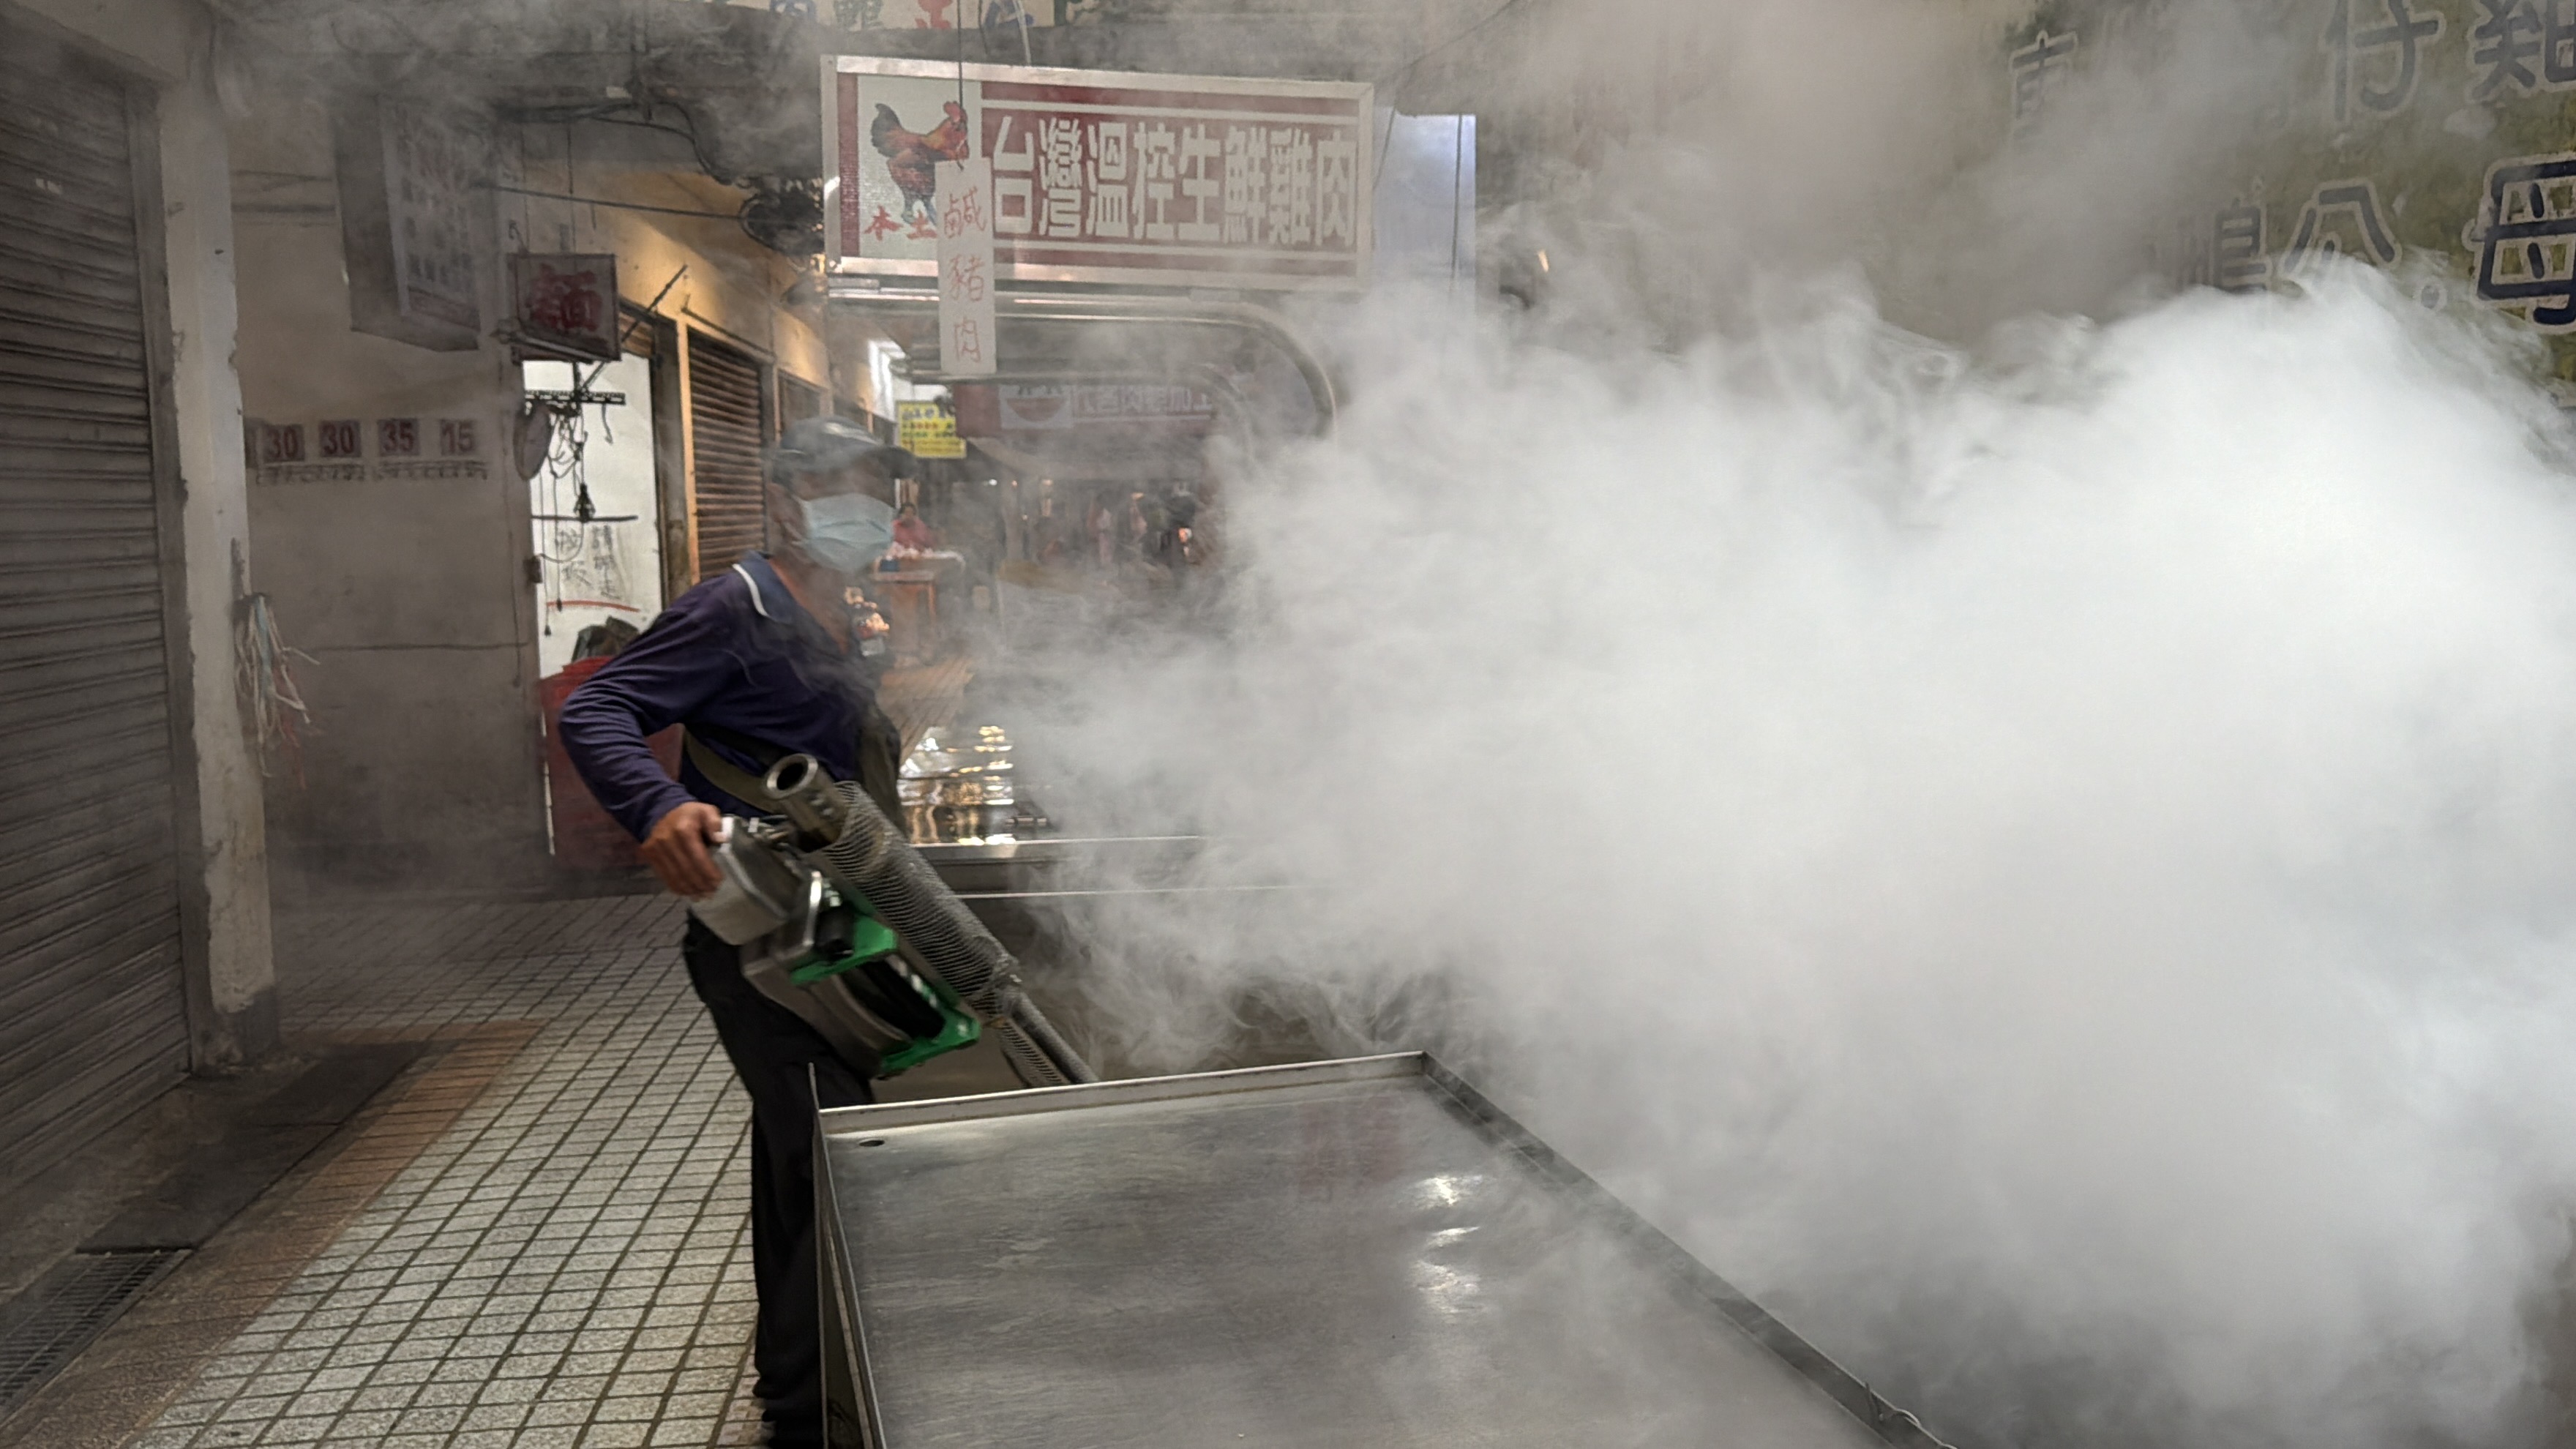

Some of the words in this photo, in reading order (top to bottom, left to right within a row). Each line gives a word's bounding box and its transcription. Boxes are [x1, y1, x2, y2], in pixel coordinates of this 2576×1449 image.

[993, 116, 1357, 247] 台灣溫控生鮮雞肉
[943, 186, 987, 363] 鹹豬肉
[322, 424, 354, 454] 30
[382, 422, 414, 452] 35
[442, 422, 474, 452] 15
